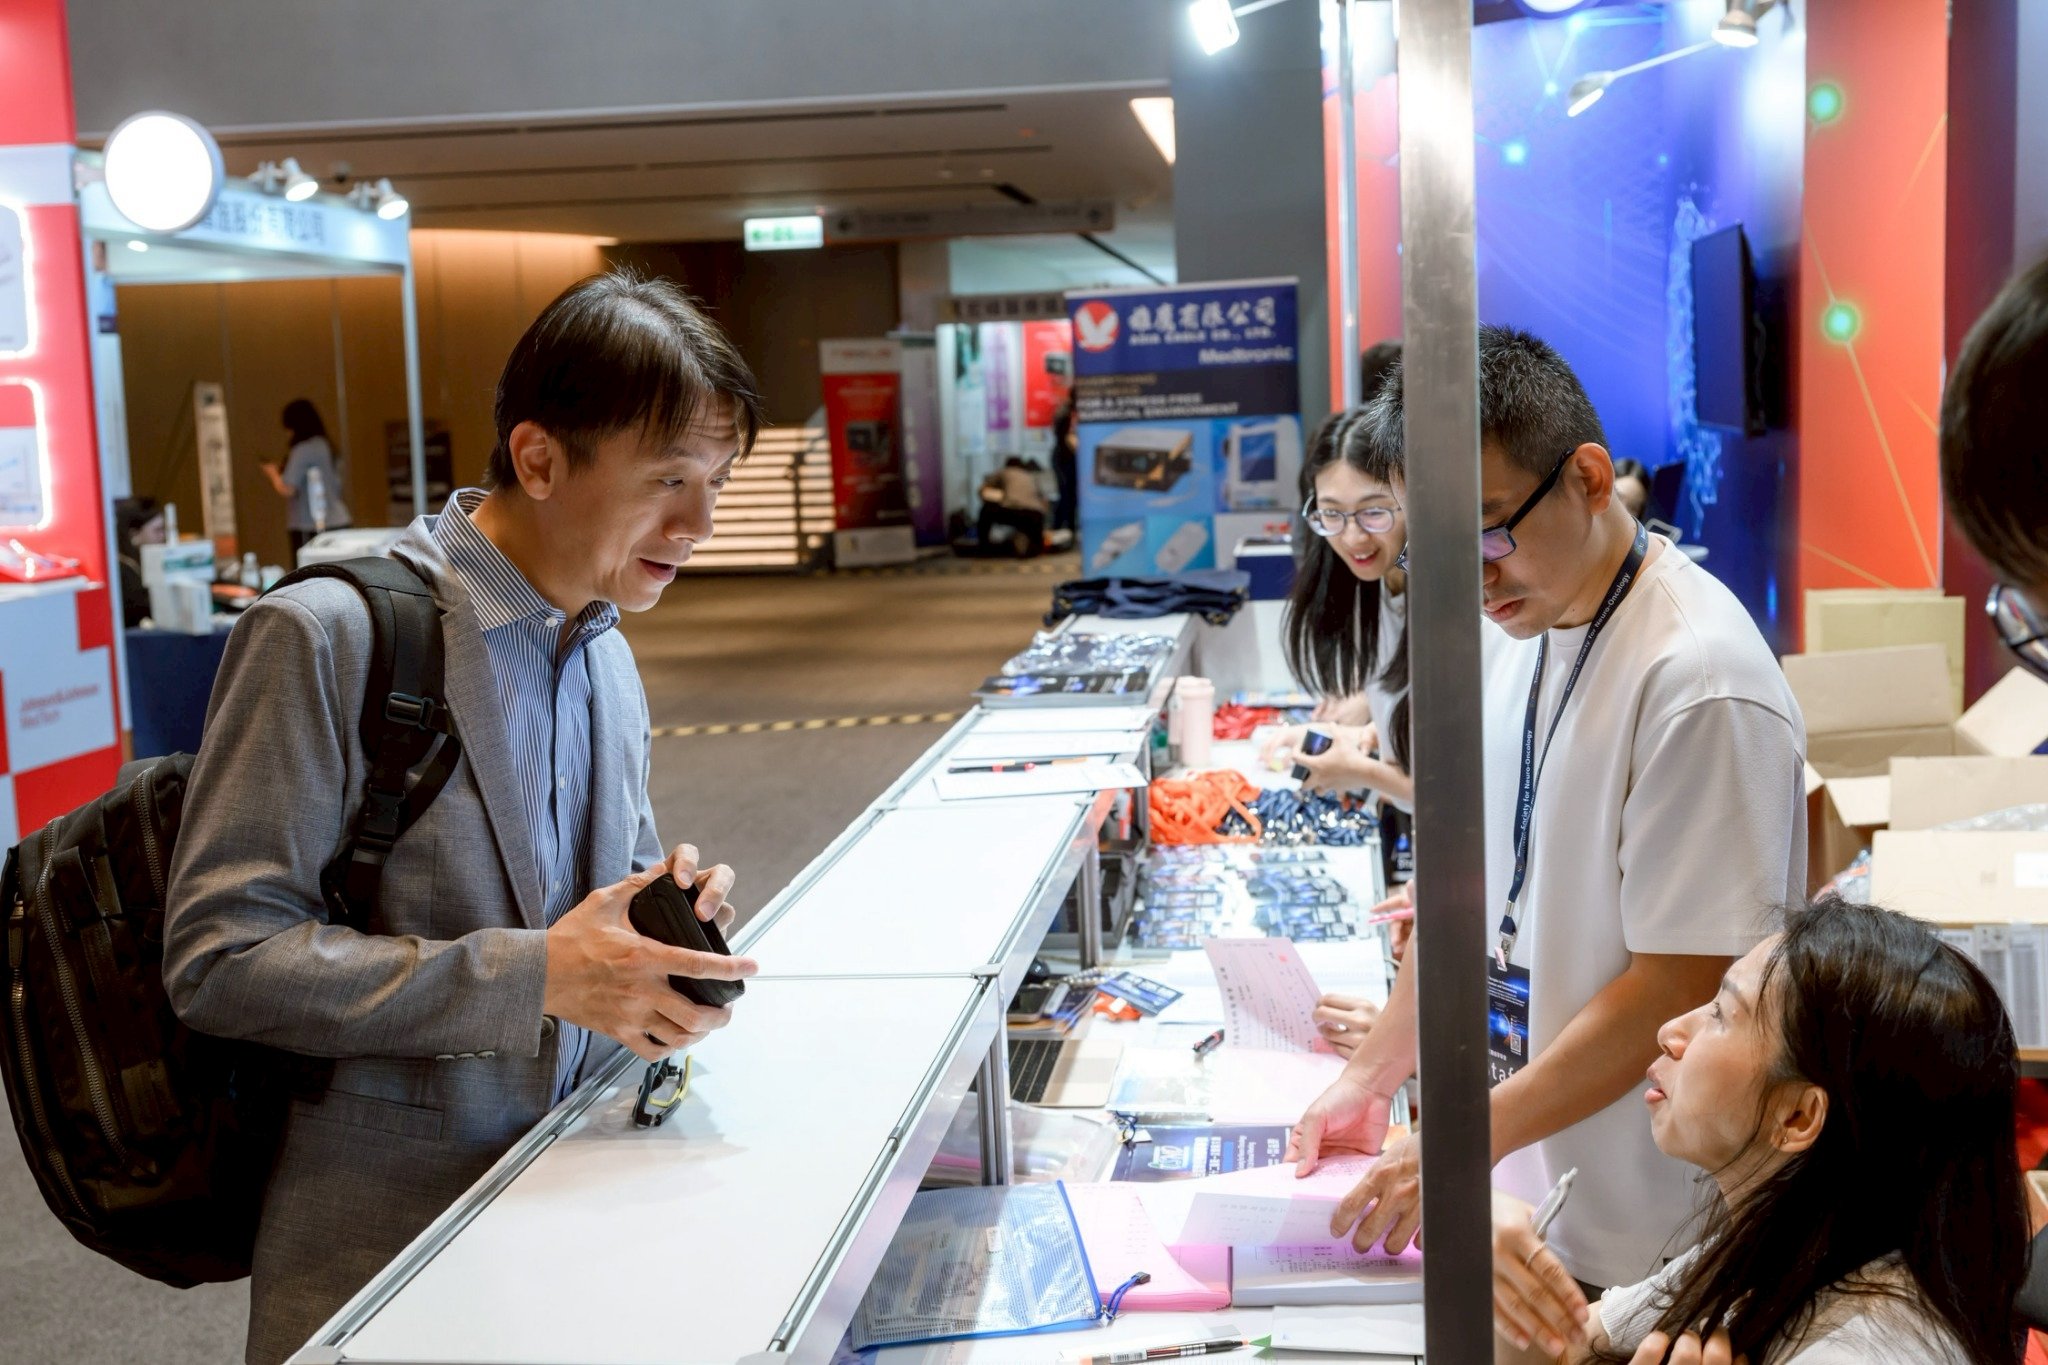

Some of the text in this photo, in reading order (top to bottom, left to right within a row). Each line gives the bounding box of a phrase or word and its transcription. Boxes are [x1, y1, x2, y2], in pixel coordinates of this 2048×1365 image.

[1199, 346, 1292, 364] Medtronic
[1143, 402, 1238, 417] ENVIRONMENT
[1577, 639, 1592, 665] Society
[1594, 572, 1631, 630] Neuro-Oncology
[1524, 730, 1534, 790] Neuro-Oncology
[1522, 790, 1531, 801] for
[1520, 801, 1532, 832] Society
[1490, 1062, 1514, 1083] taf
